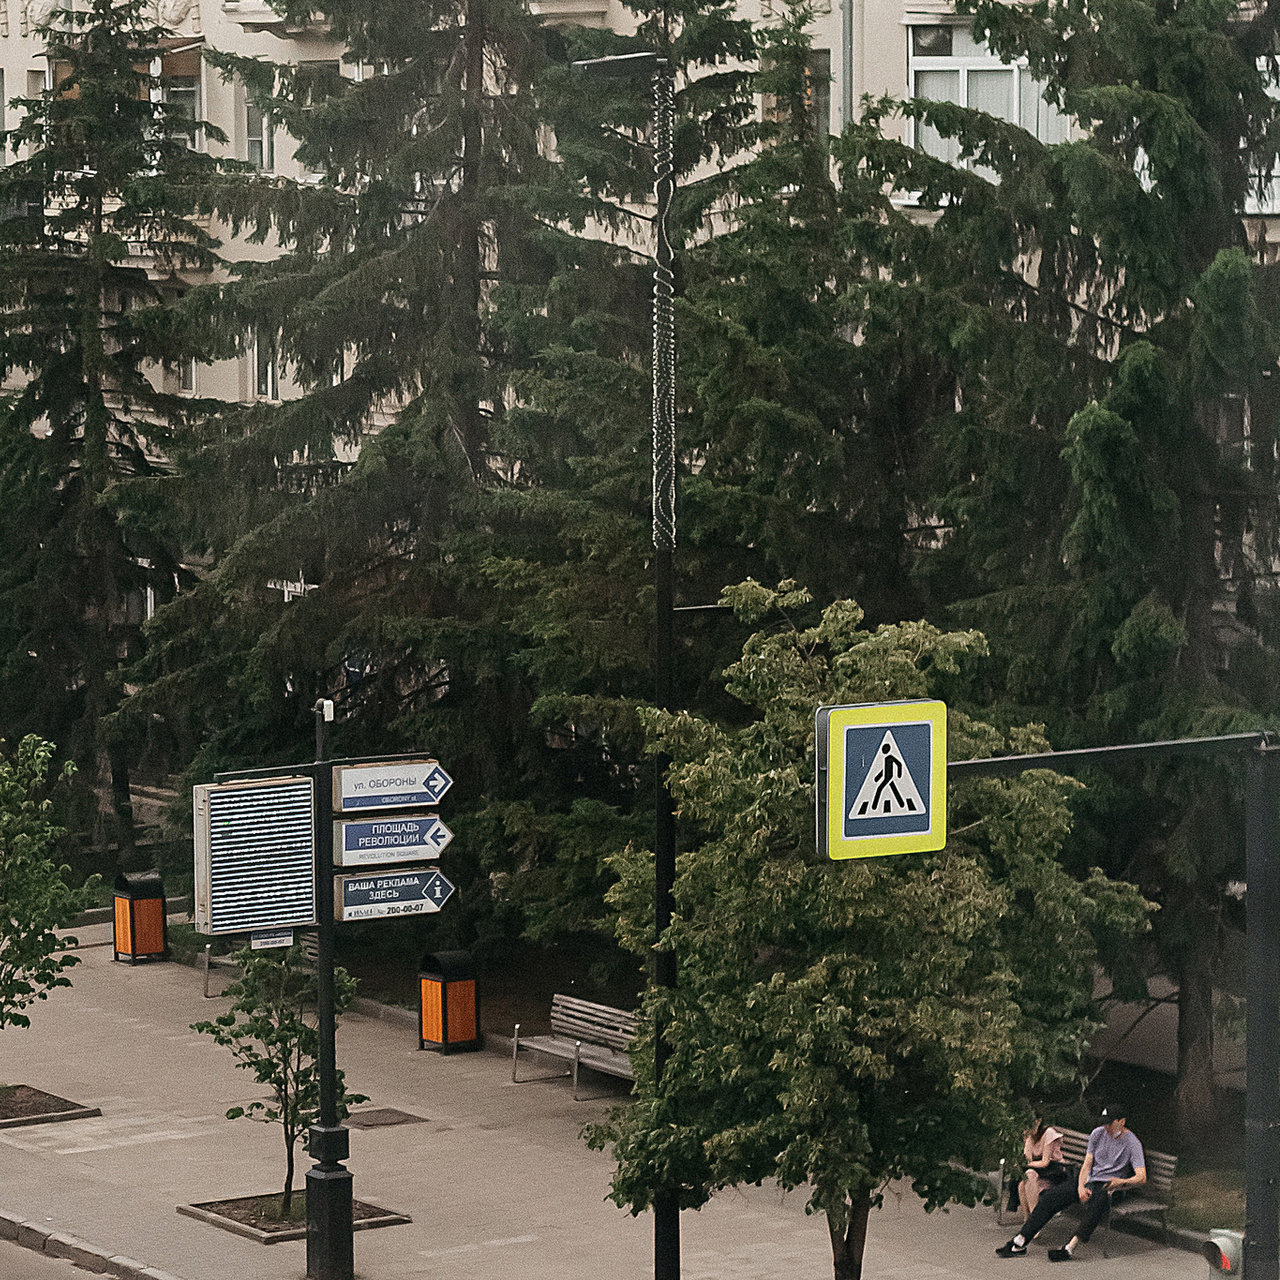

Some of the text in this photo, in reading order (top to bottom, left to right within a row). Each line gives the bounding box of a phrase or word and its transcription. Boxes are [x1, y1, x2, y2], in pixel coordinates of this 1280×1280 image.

[353, 777, 418, 792] ул. ОБОРОНЫ
[371, 822, 420, 836] ПЛОЩАДЬ
[358, 834, 420, 847] РЕВОЛЮЦИИ
[358, 849, 419, 860] REVOLUTION SQUARE
[348, 877, 420, 892] ВАША РЕКЛАМА
[369, 890, 400, 900] ЗДЕСЬ
[386, 904, 424, 915] 200-00-07
